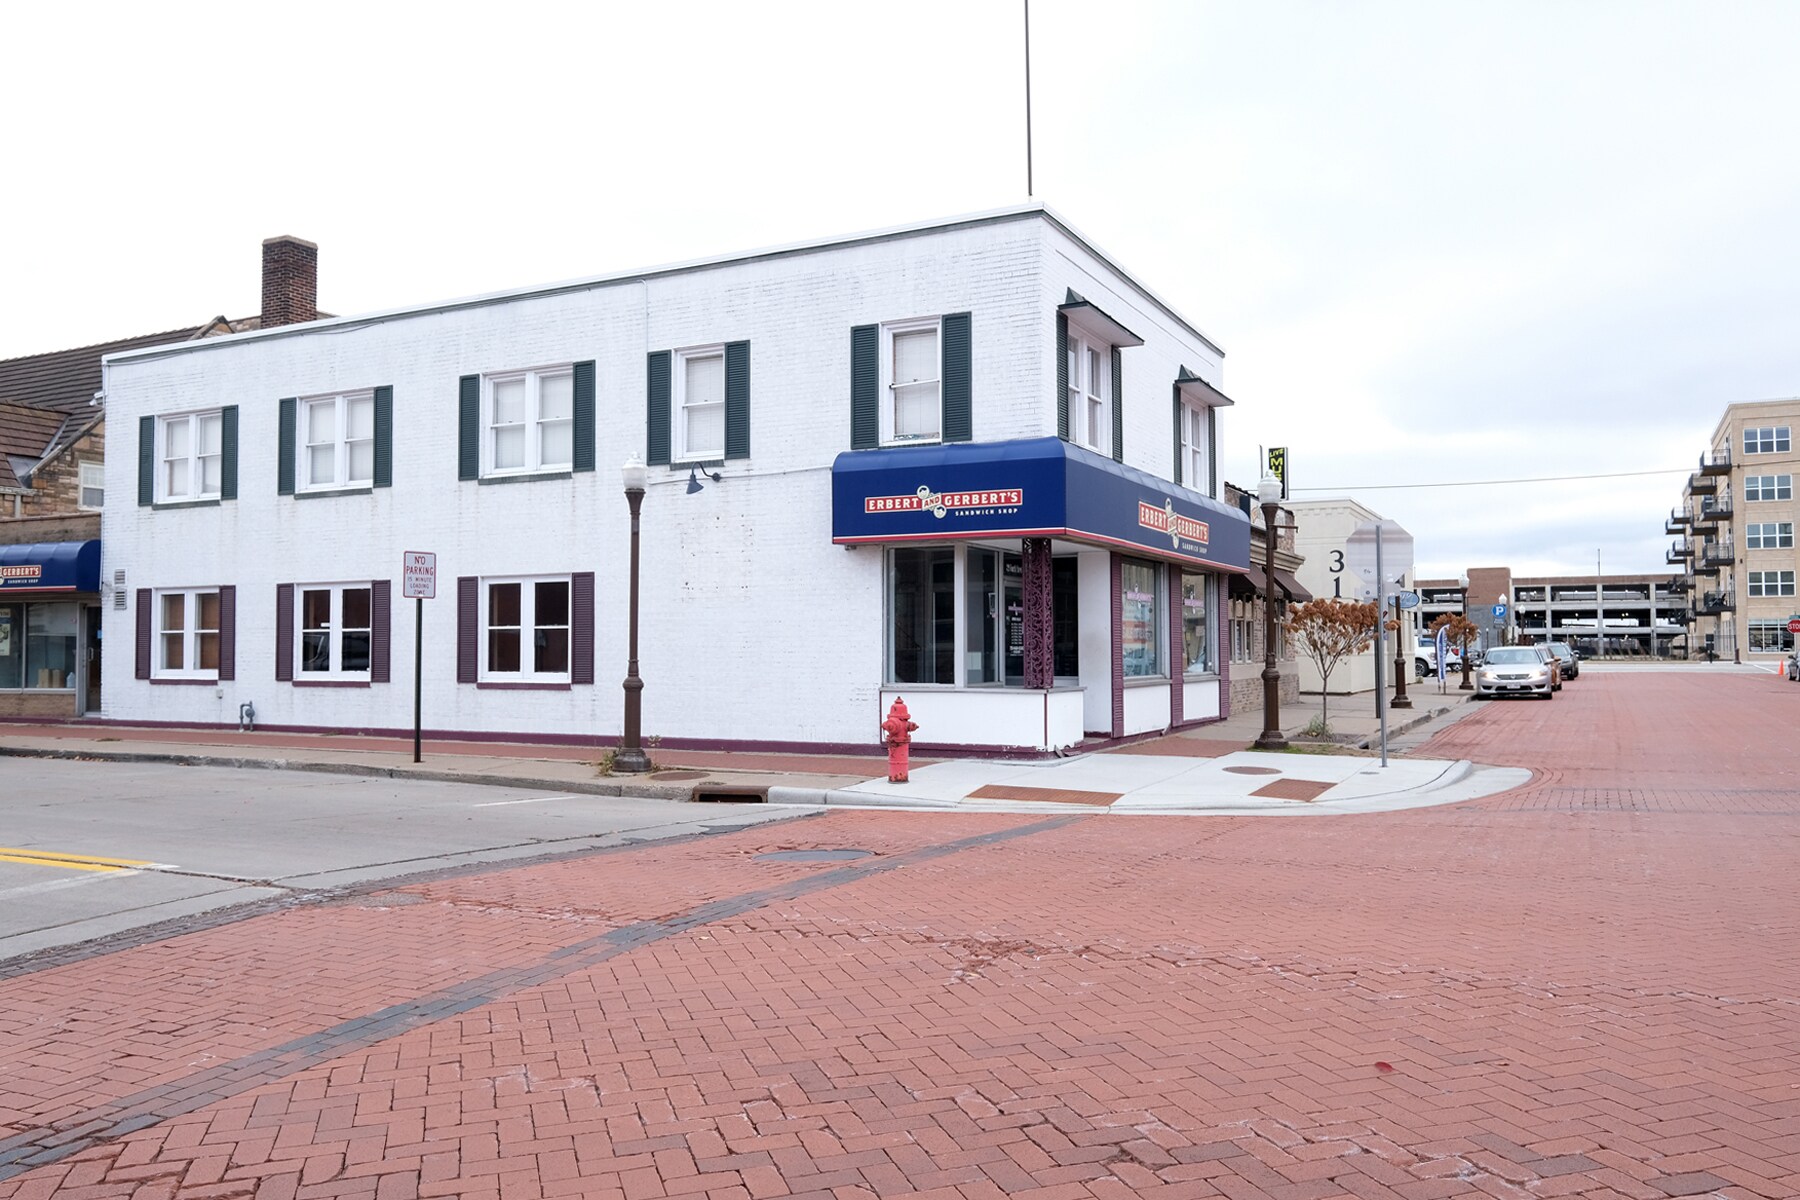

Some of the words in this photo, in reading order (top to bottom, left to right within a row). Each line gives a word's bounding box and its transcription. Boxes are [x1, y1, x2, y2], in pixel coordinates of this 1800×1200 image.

[1269, 448, 1284, 457] LIVE
[869, 498, 919, 510] ERBERT
[923, 495, 940, 508] AND
[944, 491, 1018, 506] GERBERT'S
[1141, 506, 1167, 529] ERBERT
[414, 555, 426, 565] NO
[3, 567, 39, 576] GERBERT'S
[406, 565, 434, 576] PARKING
